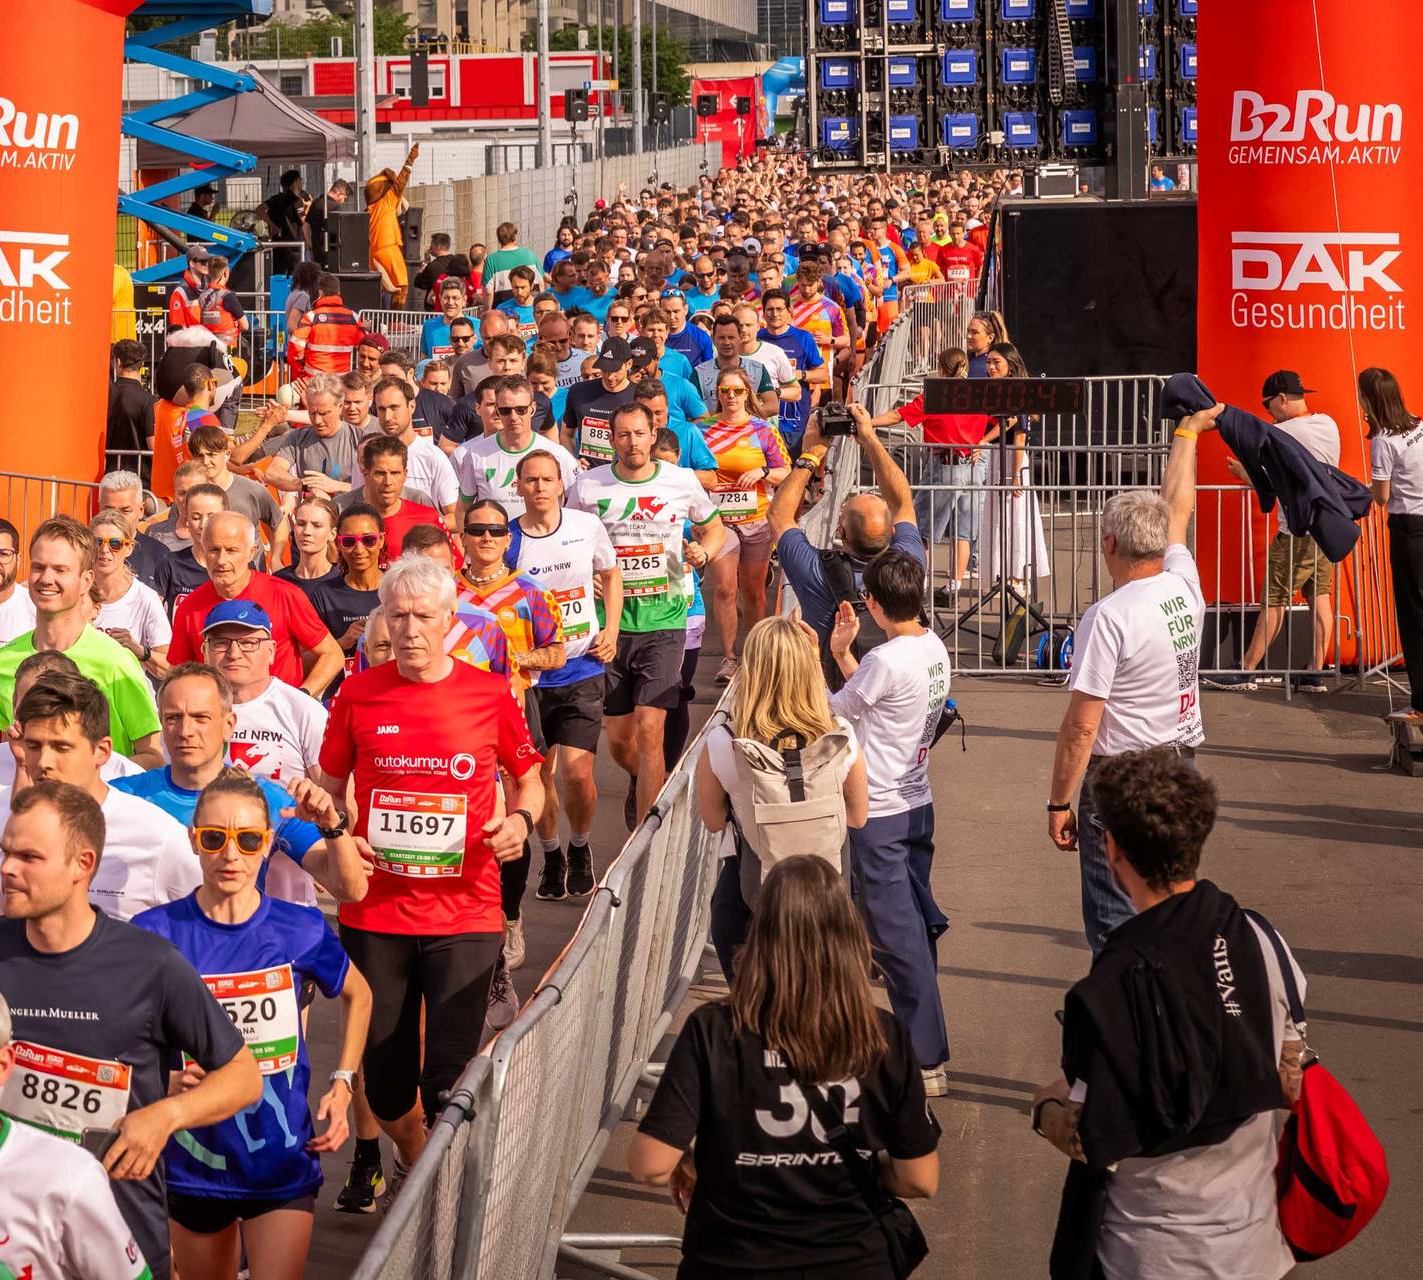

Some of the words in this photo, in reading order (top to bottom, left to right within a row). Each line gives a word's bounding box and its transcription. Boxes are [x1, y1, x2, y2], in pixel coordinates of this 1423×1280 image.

[1230, 90, 1403, 142] B2Run
[1231, 231, 1405, 292] DAK
[1231, 292, 1406, 330] Gesundheit
[719, 493, 749, 504] 7284
[542, 566, 552, 574] UK
[554, 562, 571, 571] NRW
[616, 556, 660, 571] 1265
[1160, 596, 1187, 617] WIR
[1167, 614, 1194, 637] FÜR
[1172, 631, 1197, 651] NRW
[927, 662, 944, 679] WIR
[928, 680, 945, 698] FÜR
[251, 729, 283, 742] NRW
[377, 725, 399, 735] JAKO
[374, 753, 448, 771] outokumpu
[380, 812, 455, 836] 11697
[21, 1072, 102, 1115] 8826
